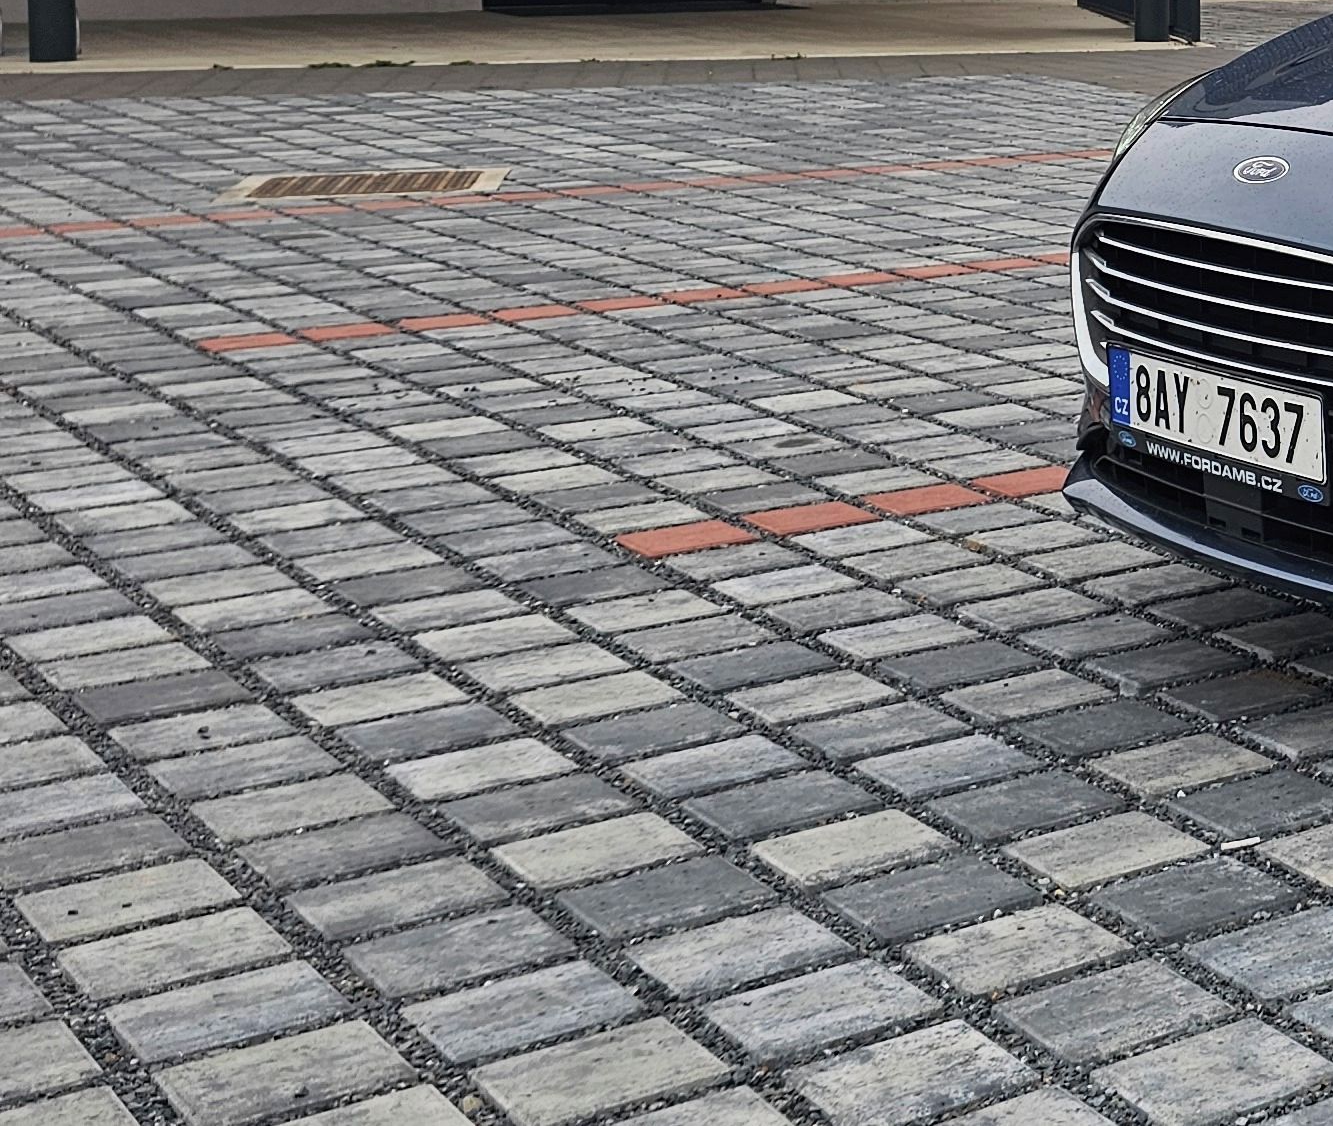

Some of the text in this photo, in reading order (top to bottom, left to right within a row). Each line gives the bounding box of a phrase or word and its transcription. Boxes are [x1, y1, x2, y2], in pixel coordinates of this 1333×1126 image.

[1114, 396, 1129, 416] CZ
[1136, 364, 1304, 464] 8AY 7637
[1146, 440, 1284, 493] WWW.FORDAMB.CZ
